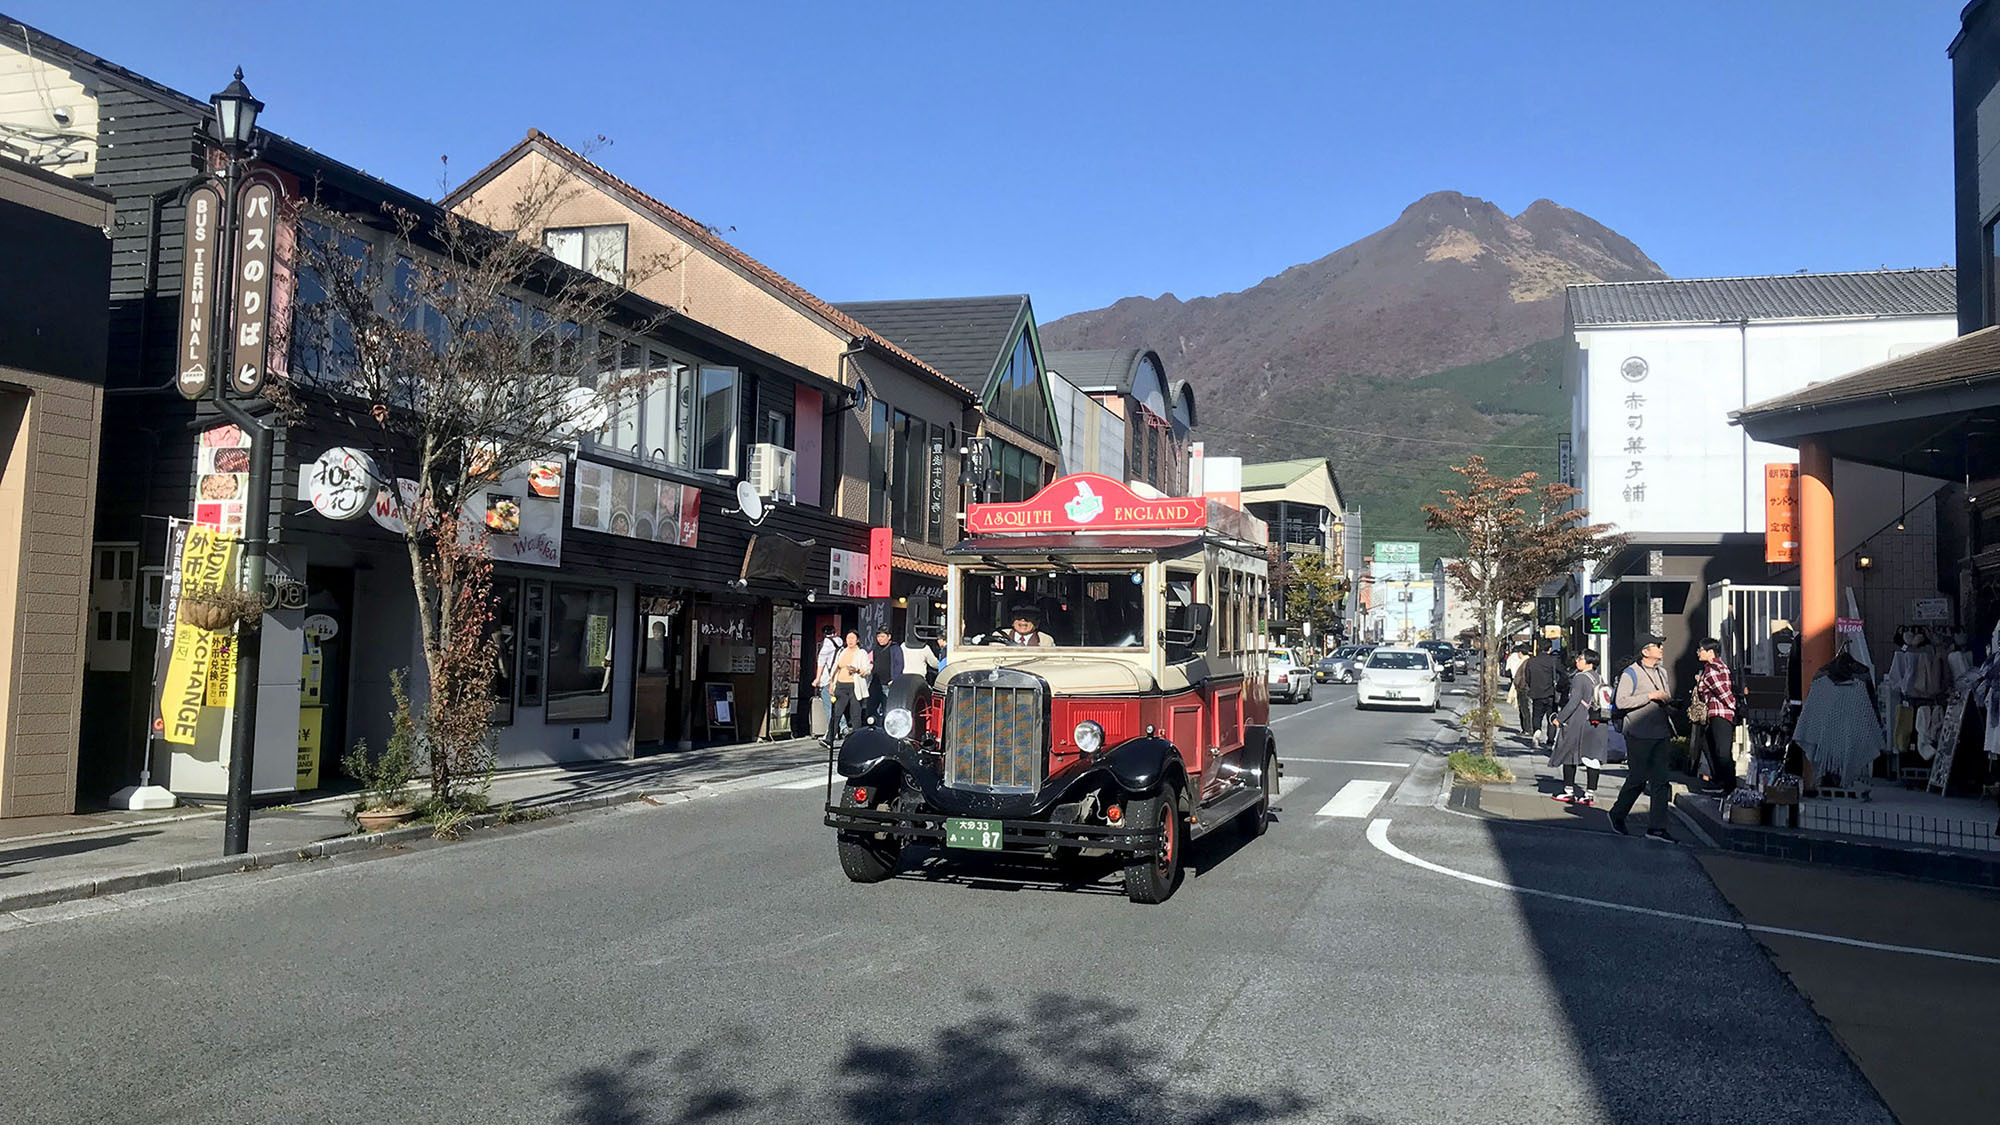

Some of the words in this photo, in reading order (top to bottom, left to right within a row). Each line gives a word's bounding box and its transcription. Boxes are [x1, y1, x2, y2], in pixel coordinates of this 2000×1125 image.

[195, 199, 208, 241] BUS
[240, 196, 269, 346] バスのりば
[189, 248, 205, 360] TERMINAL
[1622, 392, 1648, 503] 赤司菓子舗
[984, 510, 1052, 526] ASQUITH
[1115, 506, 1189, 521] ENGLAND
[184, 531, 208, 598] 外币兑
[203, 536, 230, 593] MONE
[262, 581, 302, 609] Ope
[174, 631, 210, 738] XCHANGE
[209, 637, 221, 681] 外币兑换
[981, 832, 1000, 848] 87
